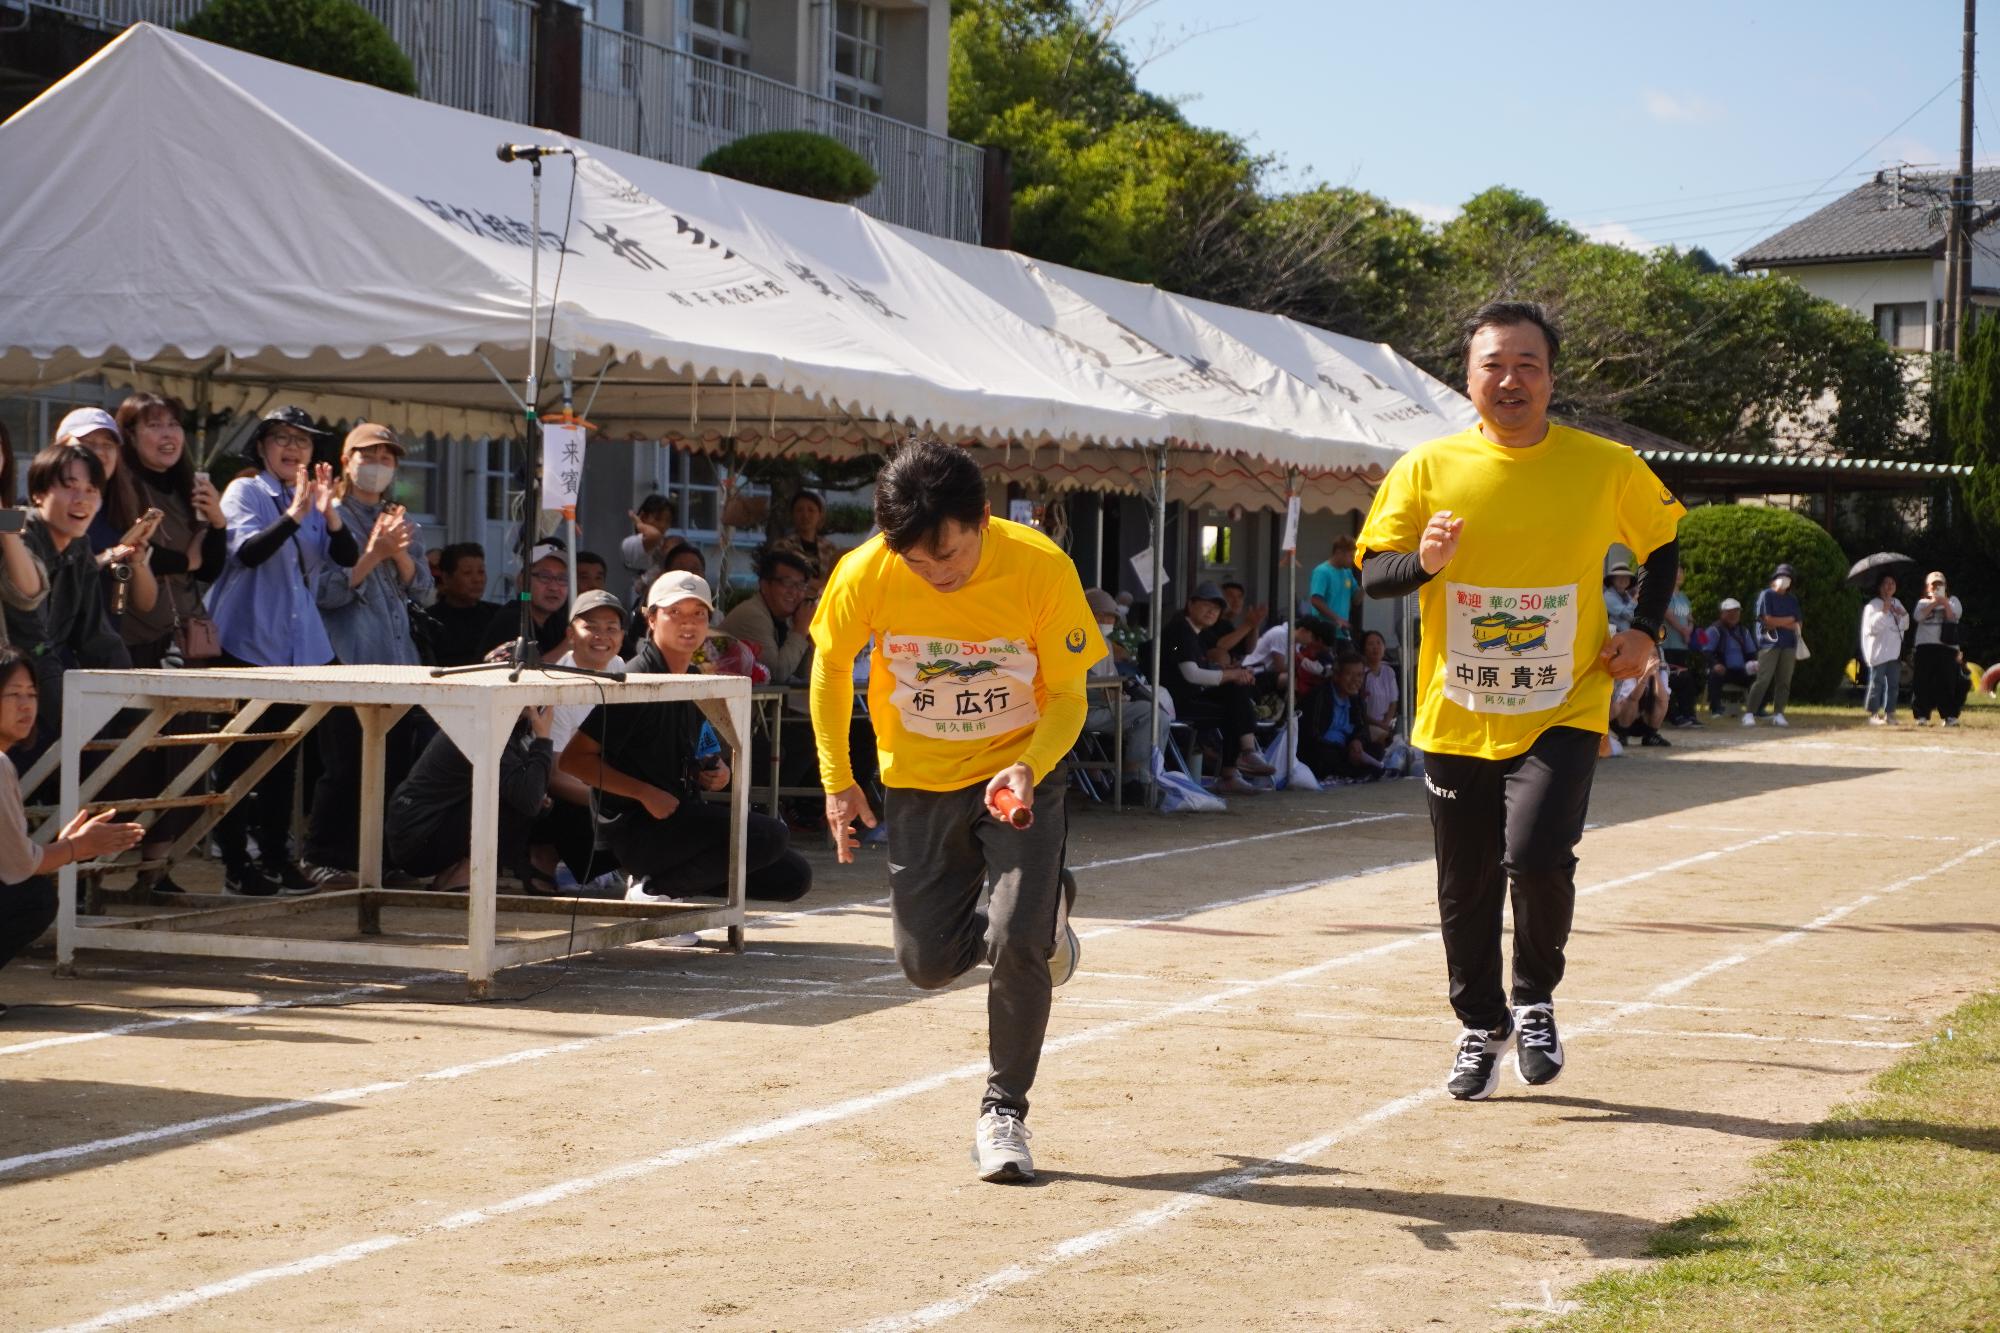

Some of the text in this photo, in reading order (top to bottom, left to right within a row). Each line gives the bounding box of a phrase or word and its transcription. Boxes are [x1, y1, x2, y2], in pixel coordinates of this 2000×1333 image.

[560, 439, 580, 495] 来賓
[1456, 663, 1557, 689] 中原 貴浩
[955, 686, 1010, 716] 広行
[935, 721, 987, 733] 阿久根市
